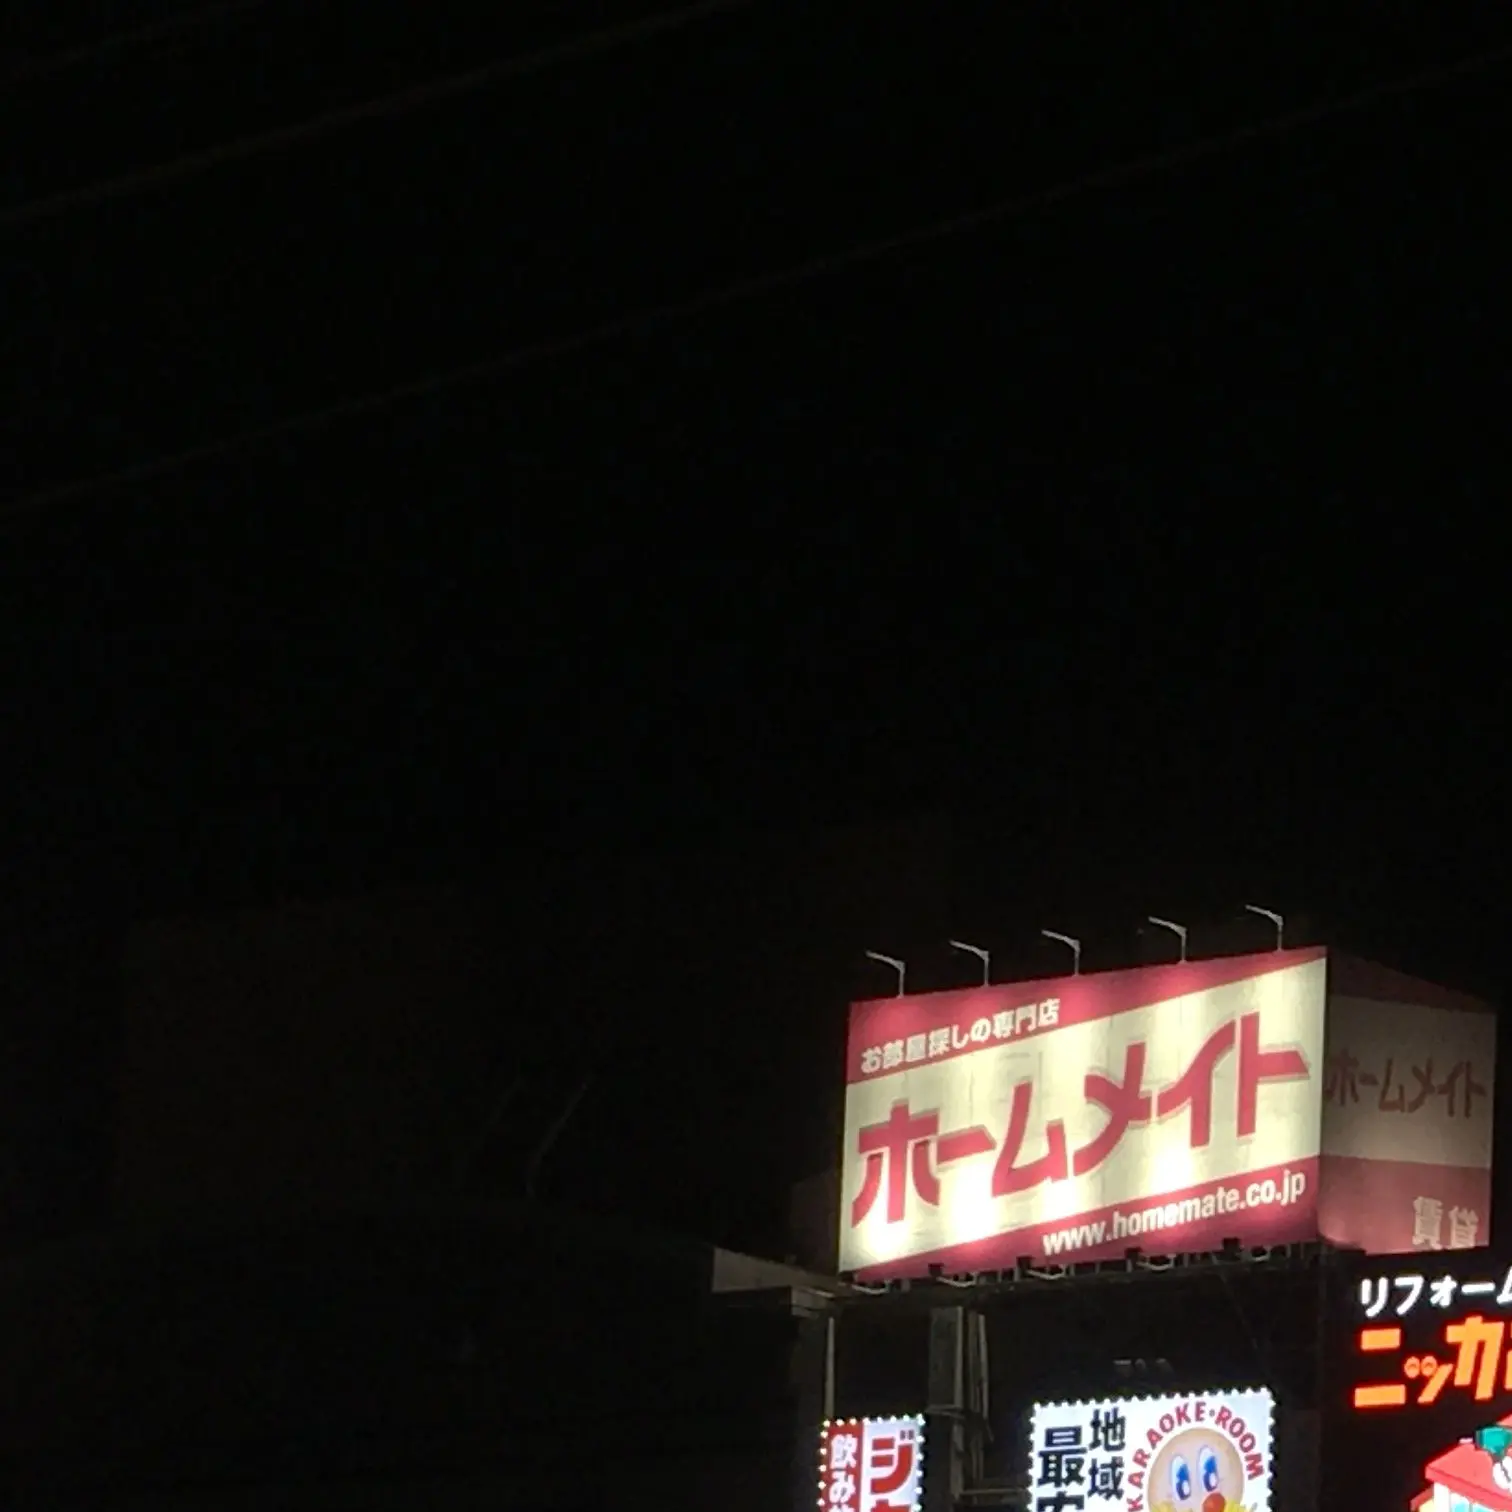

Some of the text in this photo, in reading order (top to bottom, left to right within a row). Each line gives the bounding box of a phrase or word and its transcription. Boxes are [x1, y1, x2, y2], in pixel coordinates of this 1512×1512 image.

[861, 999, 1061, 1074] お部屋探しの専門店
[852, 1011, 1311, 1229] ホームメイト
[1324, 1050, 1486, 1119] ホームメイト
[1043, 1170, 1306, 1256] www.homemate.co.jp
